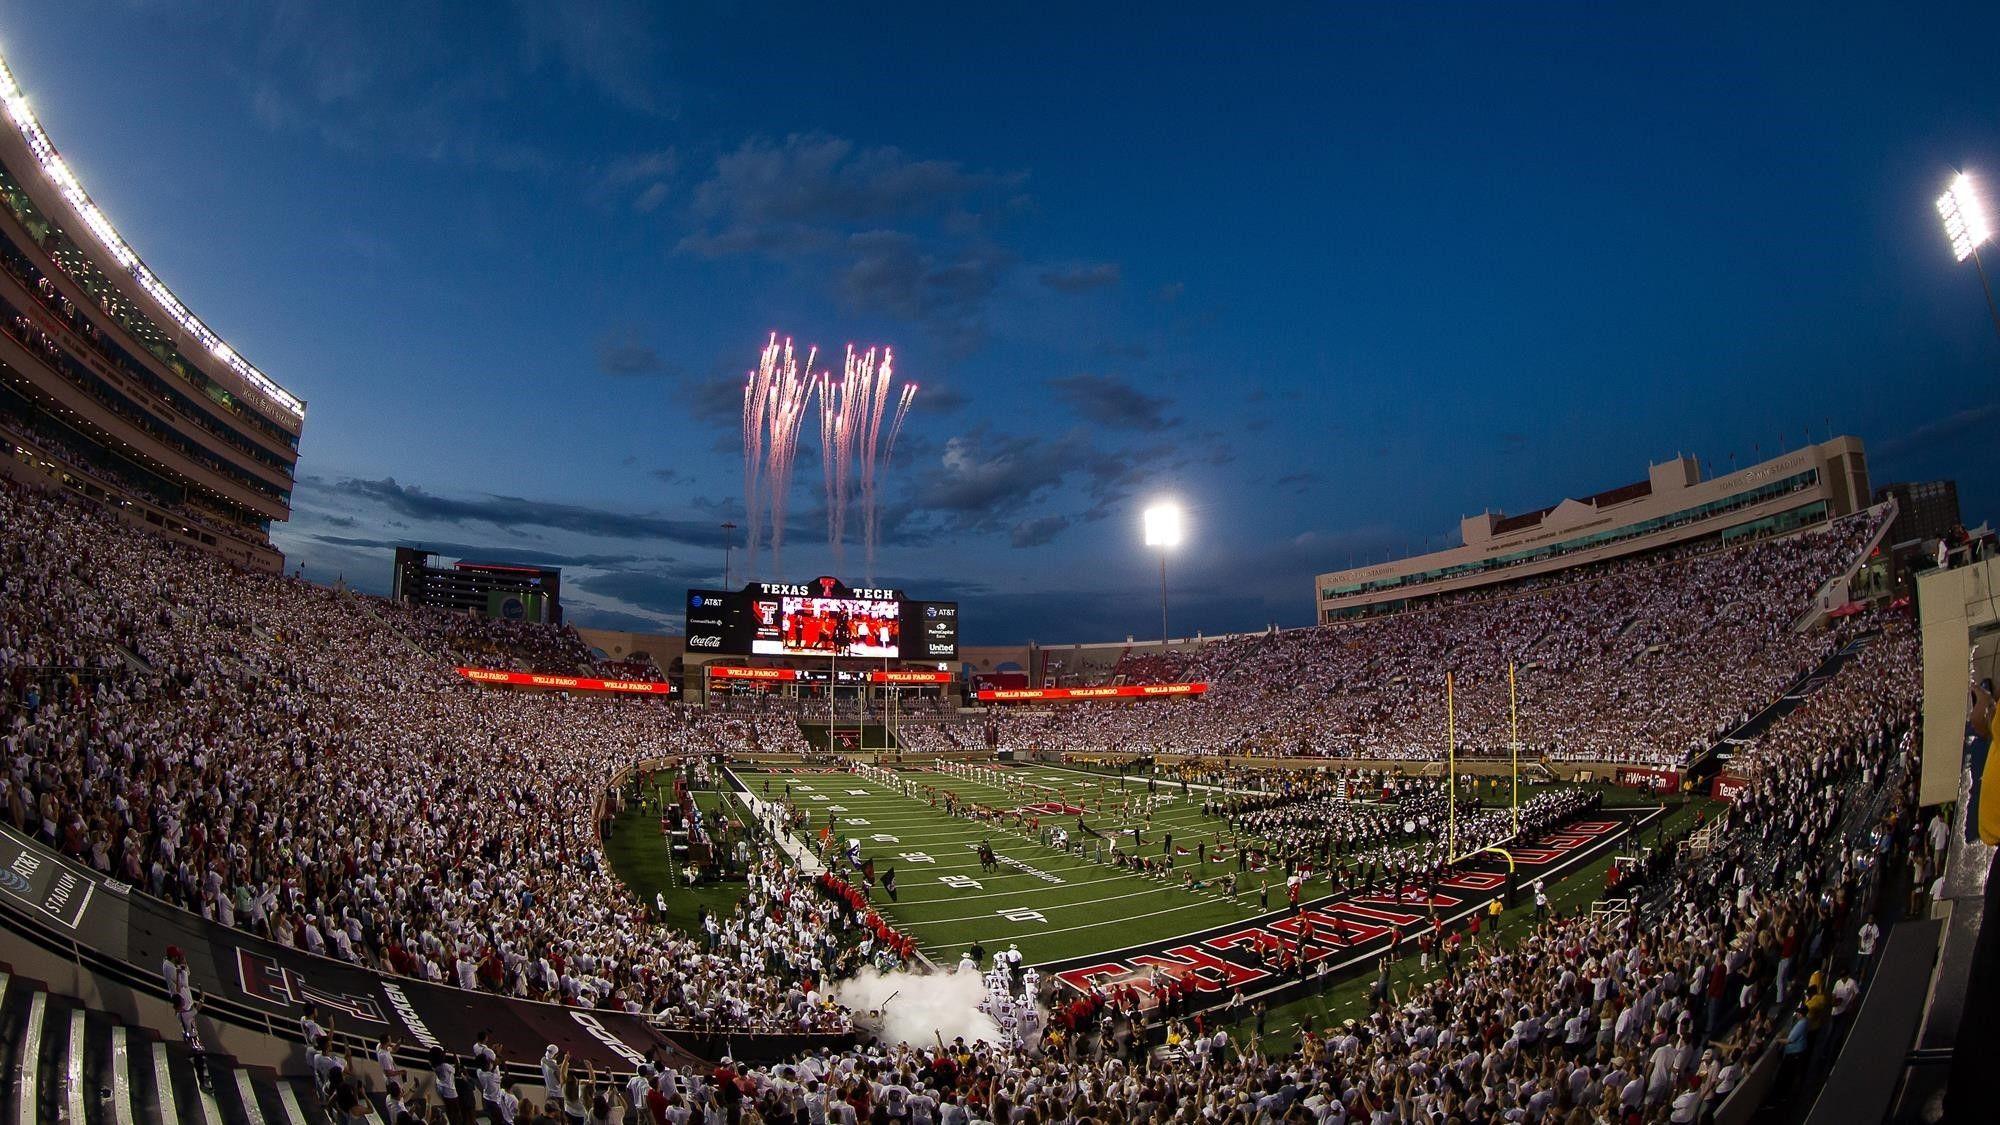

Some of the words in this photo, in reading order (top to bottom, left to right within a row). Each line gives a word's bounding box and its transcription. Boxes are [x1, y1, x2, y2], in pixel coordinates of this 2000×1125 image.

[760, 583, 809, 596] TEXAS
[853, 588, 894, 600] TECH
[704, 598, 723, 607] AT&T
[938, 608, 956, 616] AT&T
[929, 643, 954, 651] United
[468, 670, 488, 679] WELLS
[489, 672, 509, 681] FARGO
[727, 669, 753, 677] WELLS
[887, 673, 911, 681] WELLS
[532, 676, 555, 685] WELLS
[556, 678, 578, 687] FARGO
[603, 681, 627, 690] WELLS
[629, 683, 653, 692] FARGO
[1144, 686, 1167, 694] WELLS
[1168, 685, 1191, 693] FARGO
[1020, 690, 1044, 698] FARGO
[1069, 688, 1093, 696] WELLS
[1094, 688, 1118, 696] FARGO
[10, 851, 41, 880] AT&T
[45, 872, 77, 914] STADIUM
[996, 907, 1043, 922] 10
